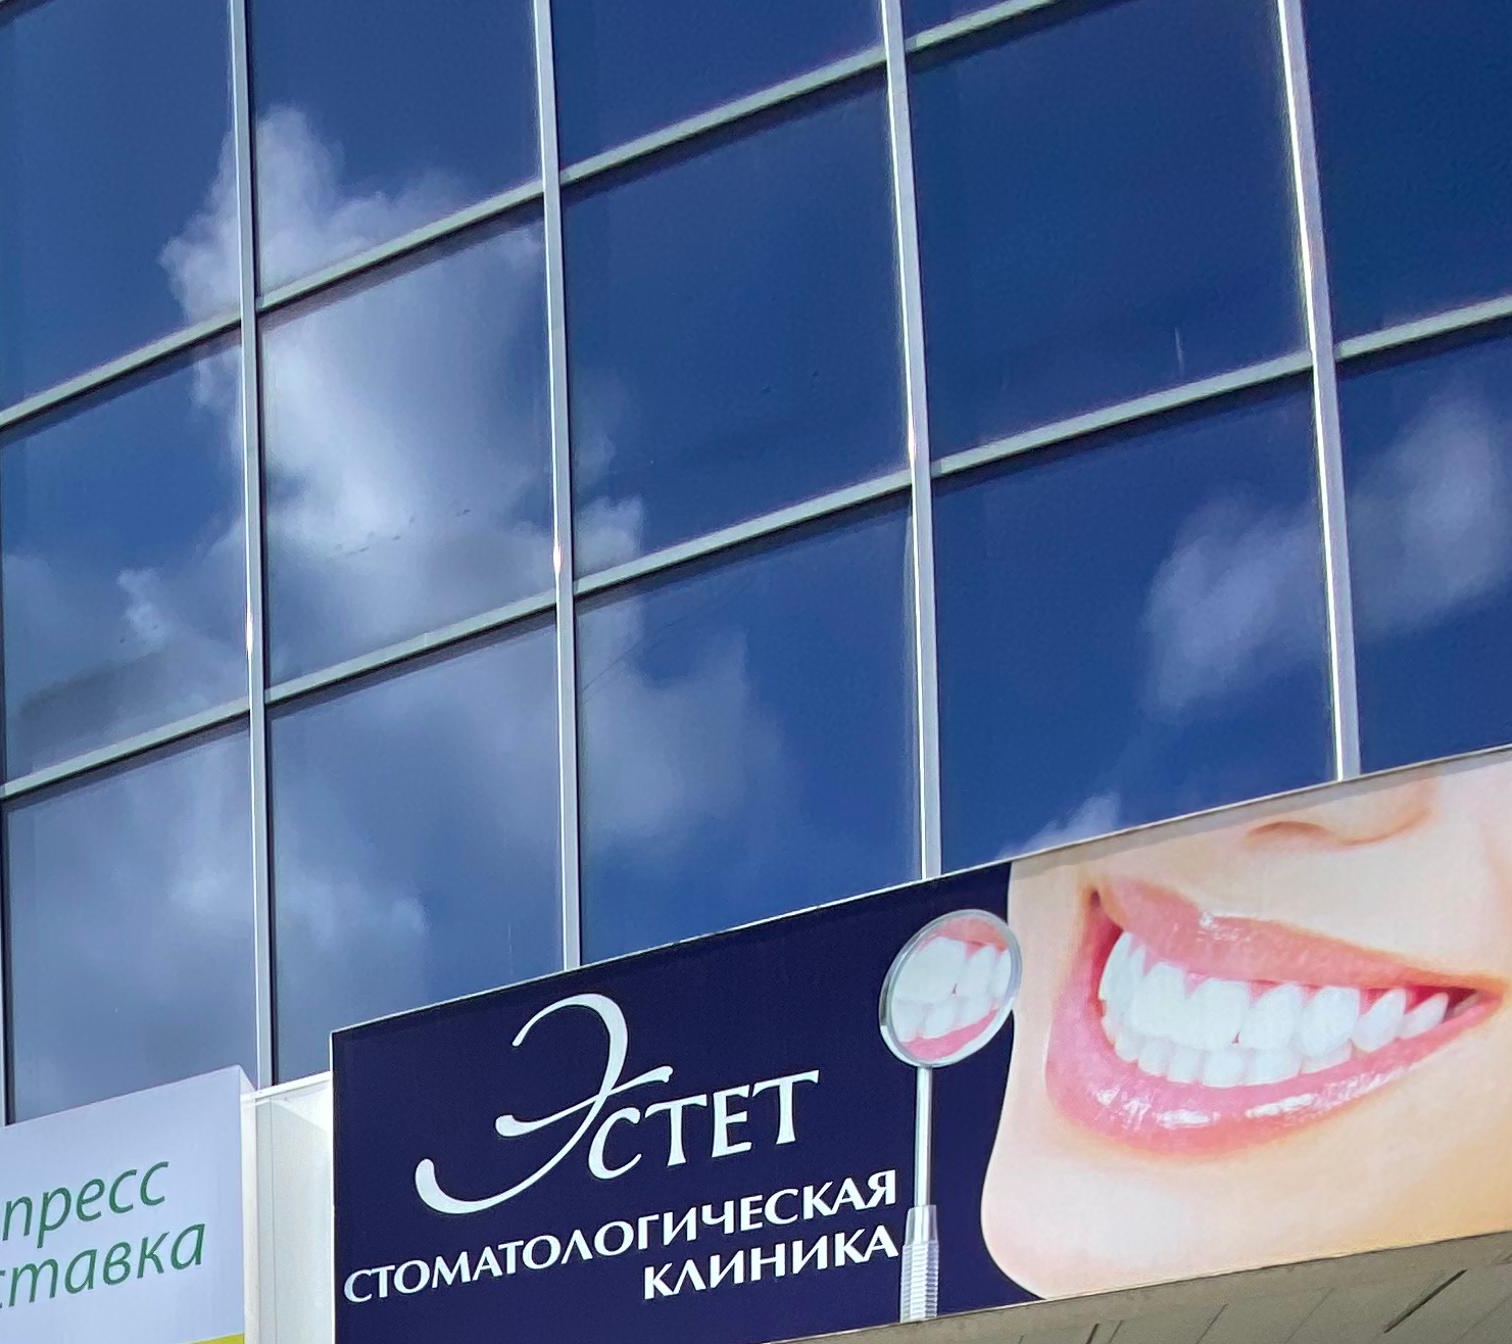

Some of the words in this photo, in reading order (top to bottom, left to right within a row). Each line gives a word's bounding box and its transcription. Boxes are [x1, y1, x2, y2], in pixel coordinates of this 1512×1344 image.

[415, 993, 819, 1215] ЭСТЕТ
[344, 1169, 897, 1303] СТОМАТОЛОГИЧЕСКАЯ
[644, 1223, 900, 1300] КЛИНИКА
